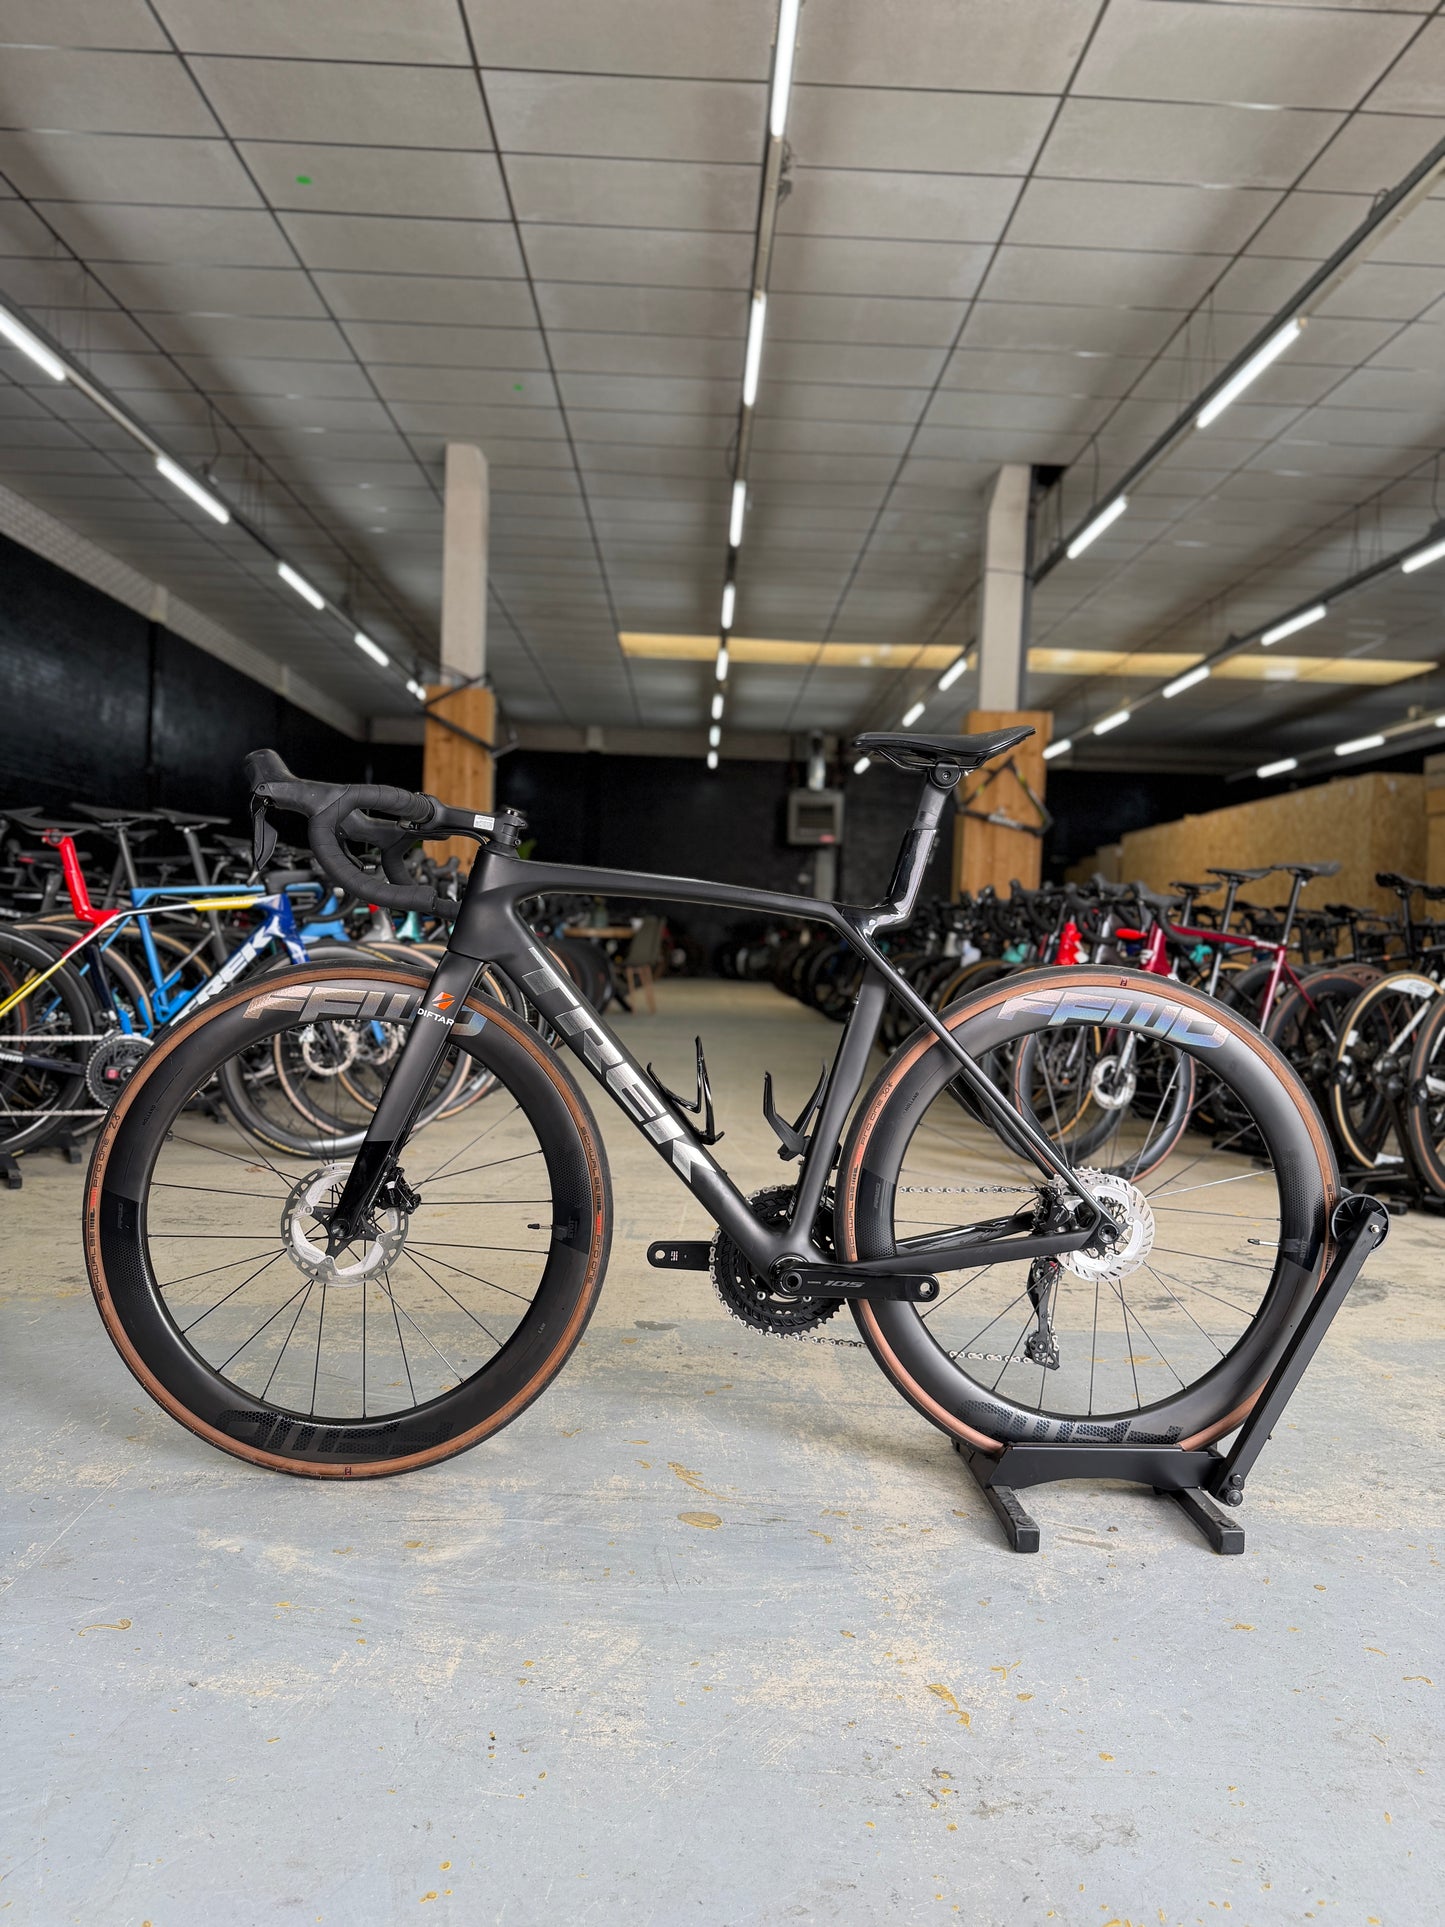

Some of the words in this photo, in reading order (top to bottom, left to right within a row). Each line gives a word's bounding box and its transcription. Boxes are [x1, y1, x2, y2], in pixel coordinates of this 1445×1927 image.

[417, 1007, 455, 1026] DIFTAR
[521, 946, 717, 1183] TREK
[824, 1280, 866, 1288] 105
